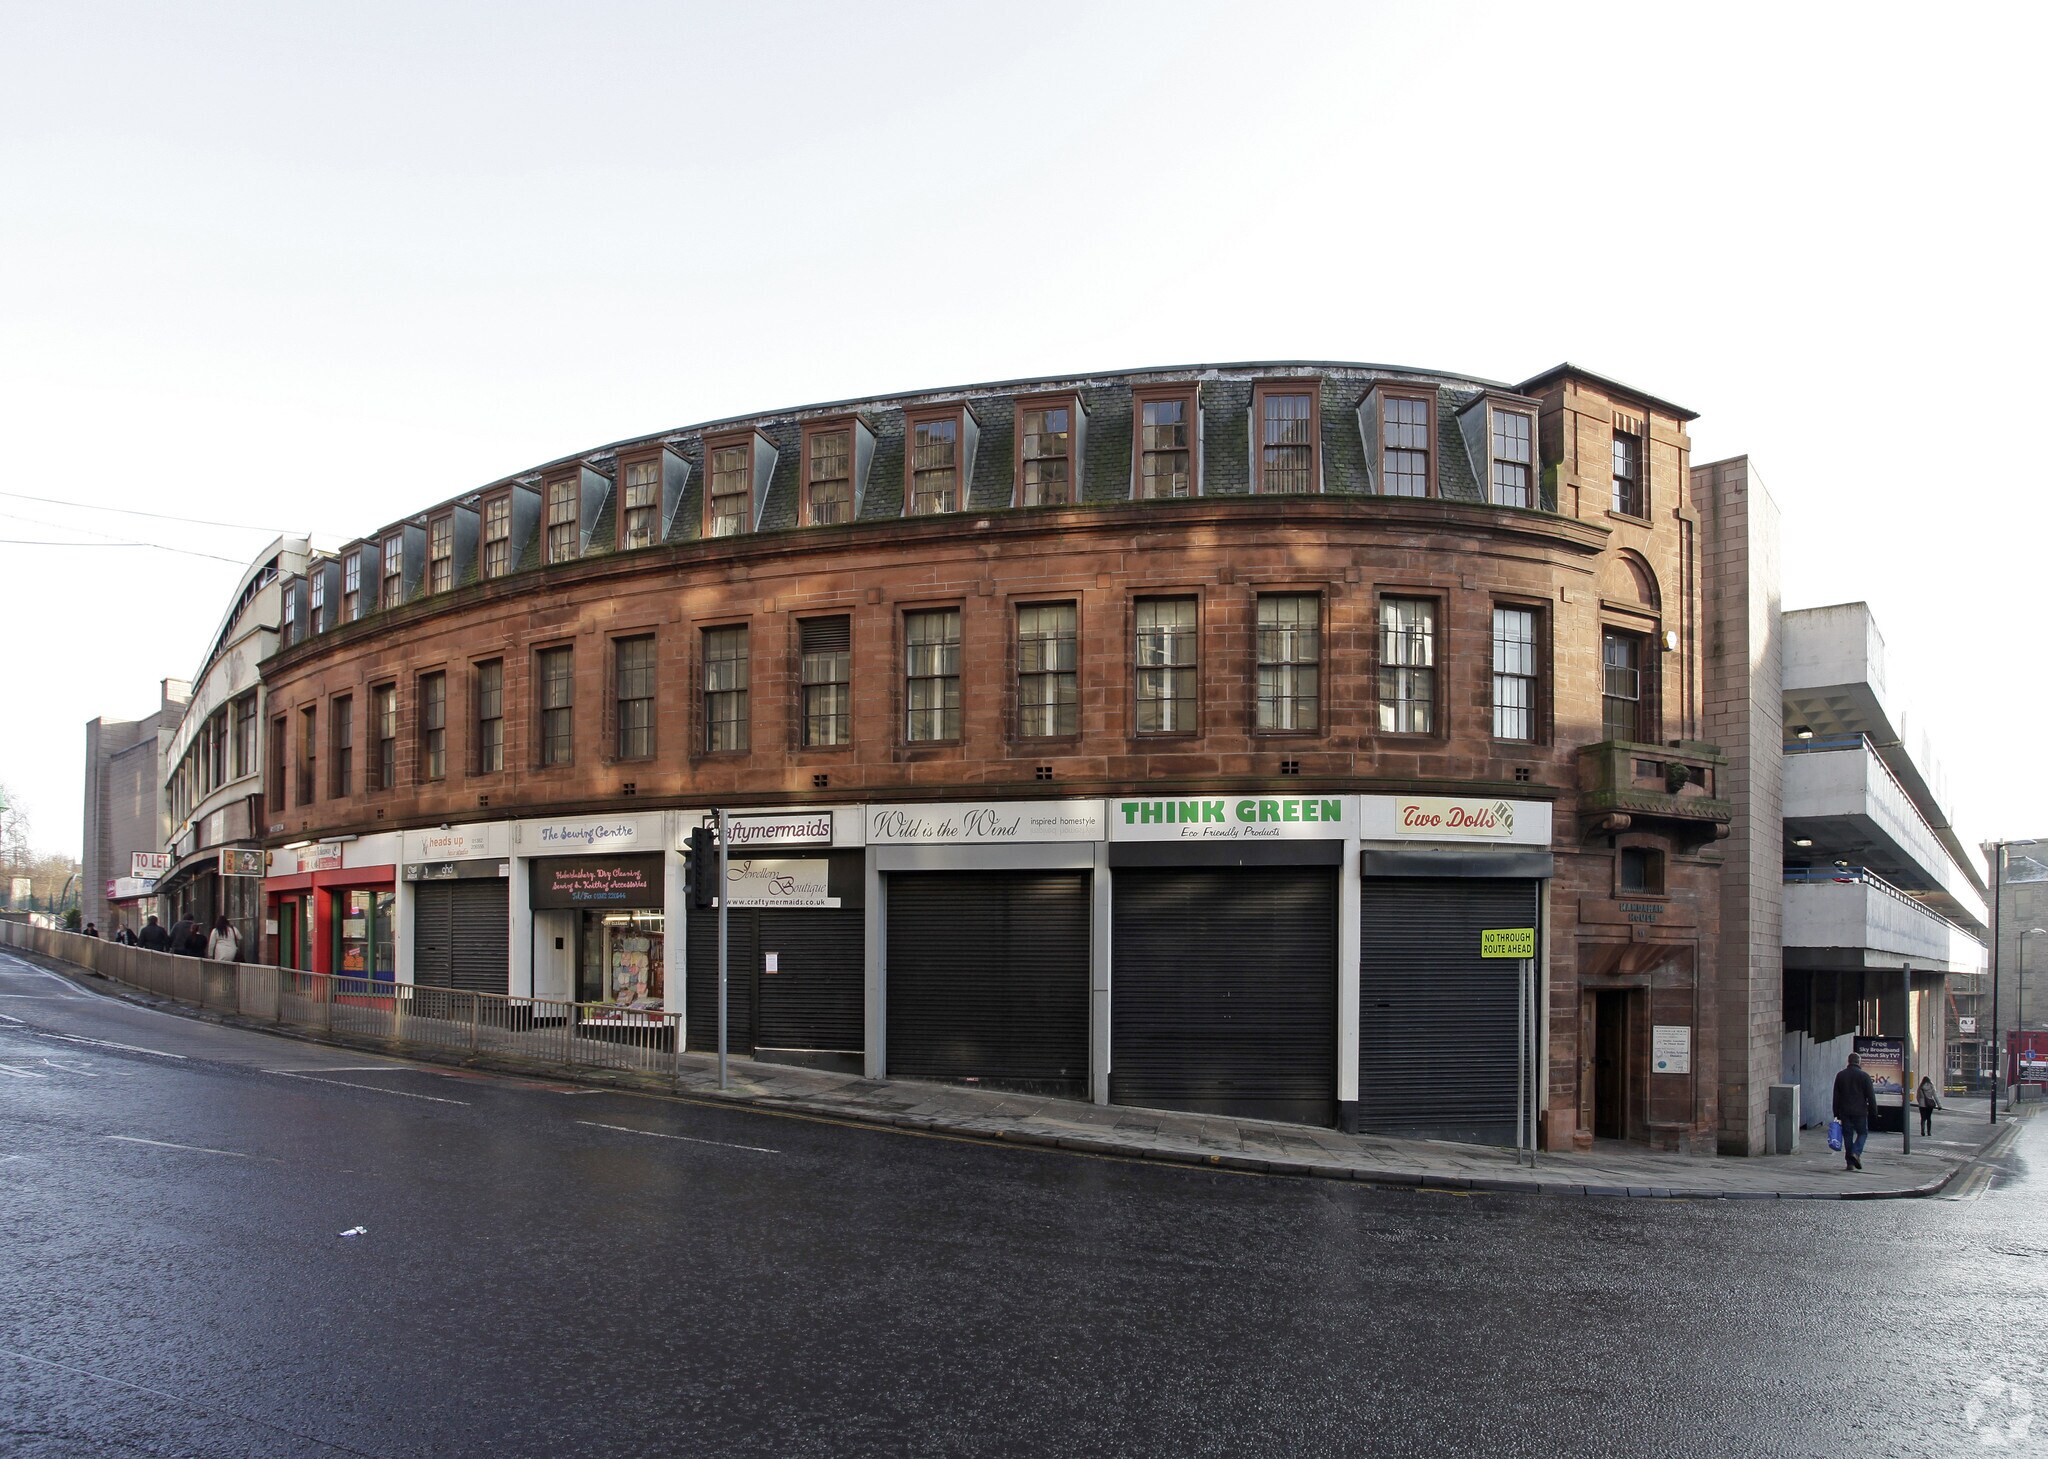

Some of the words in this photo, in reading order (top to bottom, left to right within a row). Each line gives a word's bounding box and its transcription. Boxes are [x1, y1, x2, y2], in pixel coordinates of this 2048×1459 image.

[1121, 800, 1226, 824] THINK
[1235, 799, 1341, 822] GREEN
[1403, 805, 1442, 827] Two
[1446, 806, 1497, 828] Dolls
[873, 809, 919, 838] Wild
[922, 821, 934, 837] is
[936, 818, 959, 837] the
[963, 808, 1021, 836] Wind
[1030, 817, 1057, 826] inspired
[1059, 817, 1096, 826] homestyle
[542, 825, 558, 840] The
[560, 826, 594, 844] Sewing
[595, 825, 633, 838] Centre
[1181, 826, 1199, 837] Eco
[1203, 825, 1239, 839] Friendly
[1244, 825, 1280, 837] Products
[429, 836, 452, 848] heads
[454, 836, 464, 847] up
[136, 853, 148, 867] TO
[151, 854, 168, 868] LET
[442, 864, 453, 877] ghd
[596, 868, 612, 881] Dry
[727, 860, 780, 881] Jewellery
[552, 881, 574, 892] Sewing
[583, 880, 610, 892] Knitting
[610, 880, 647, 888] Accessories
[768, 876, 826, 898] Boutique
[727, 898, 825, 906] www.craftymermaids.co.uk
[1628, 913, 1657, 922] HOUSE
[1485, 934, 1495, 942] NO
[1497, 933, 1531, 942] THROUGH
[1484, 944, 1506, 953] ROUTE
[1508, 944, 1532, 953] AHEAD
